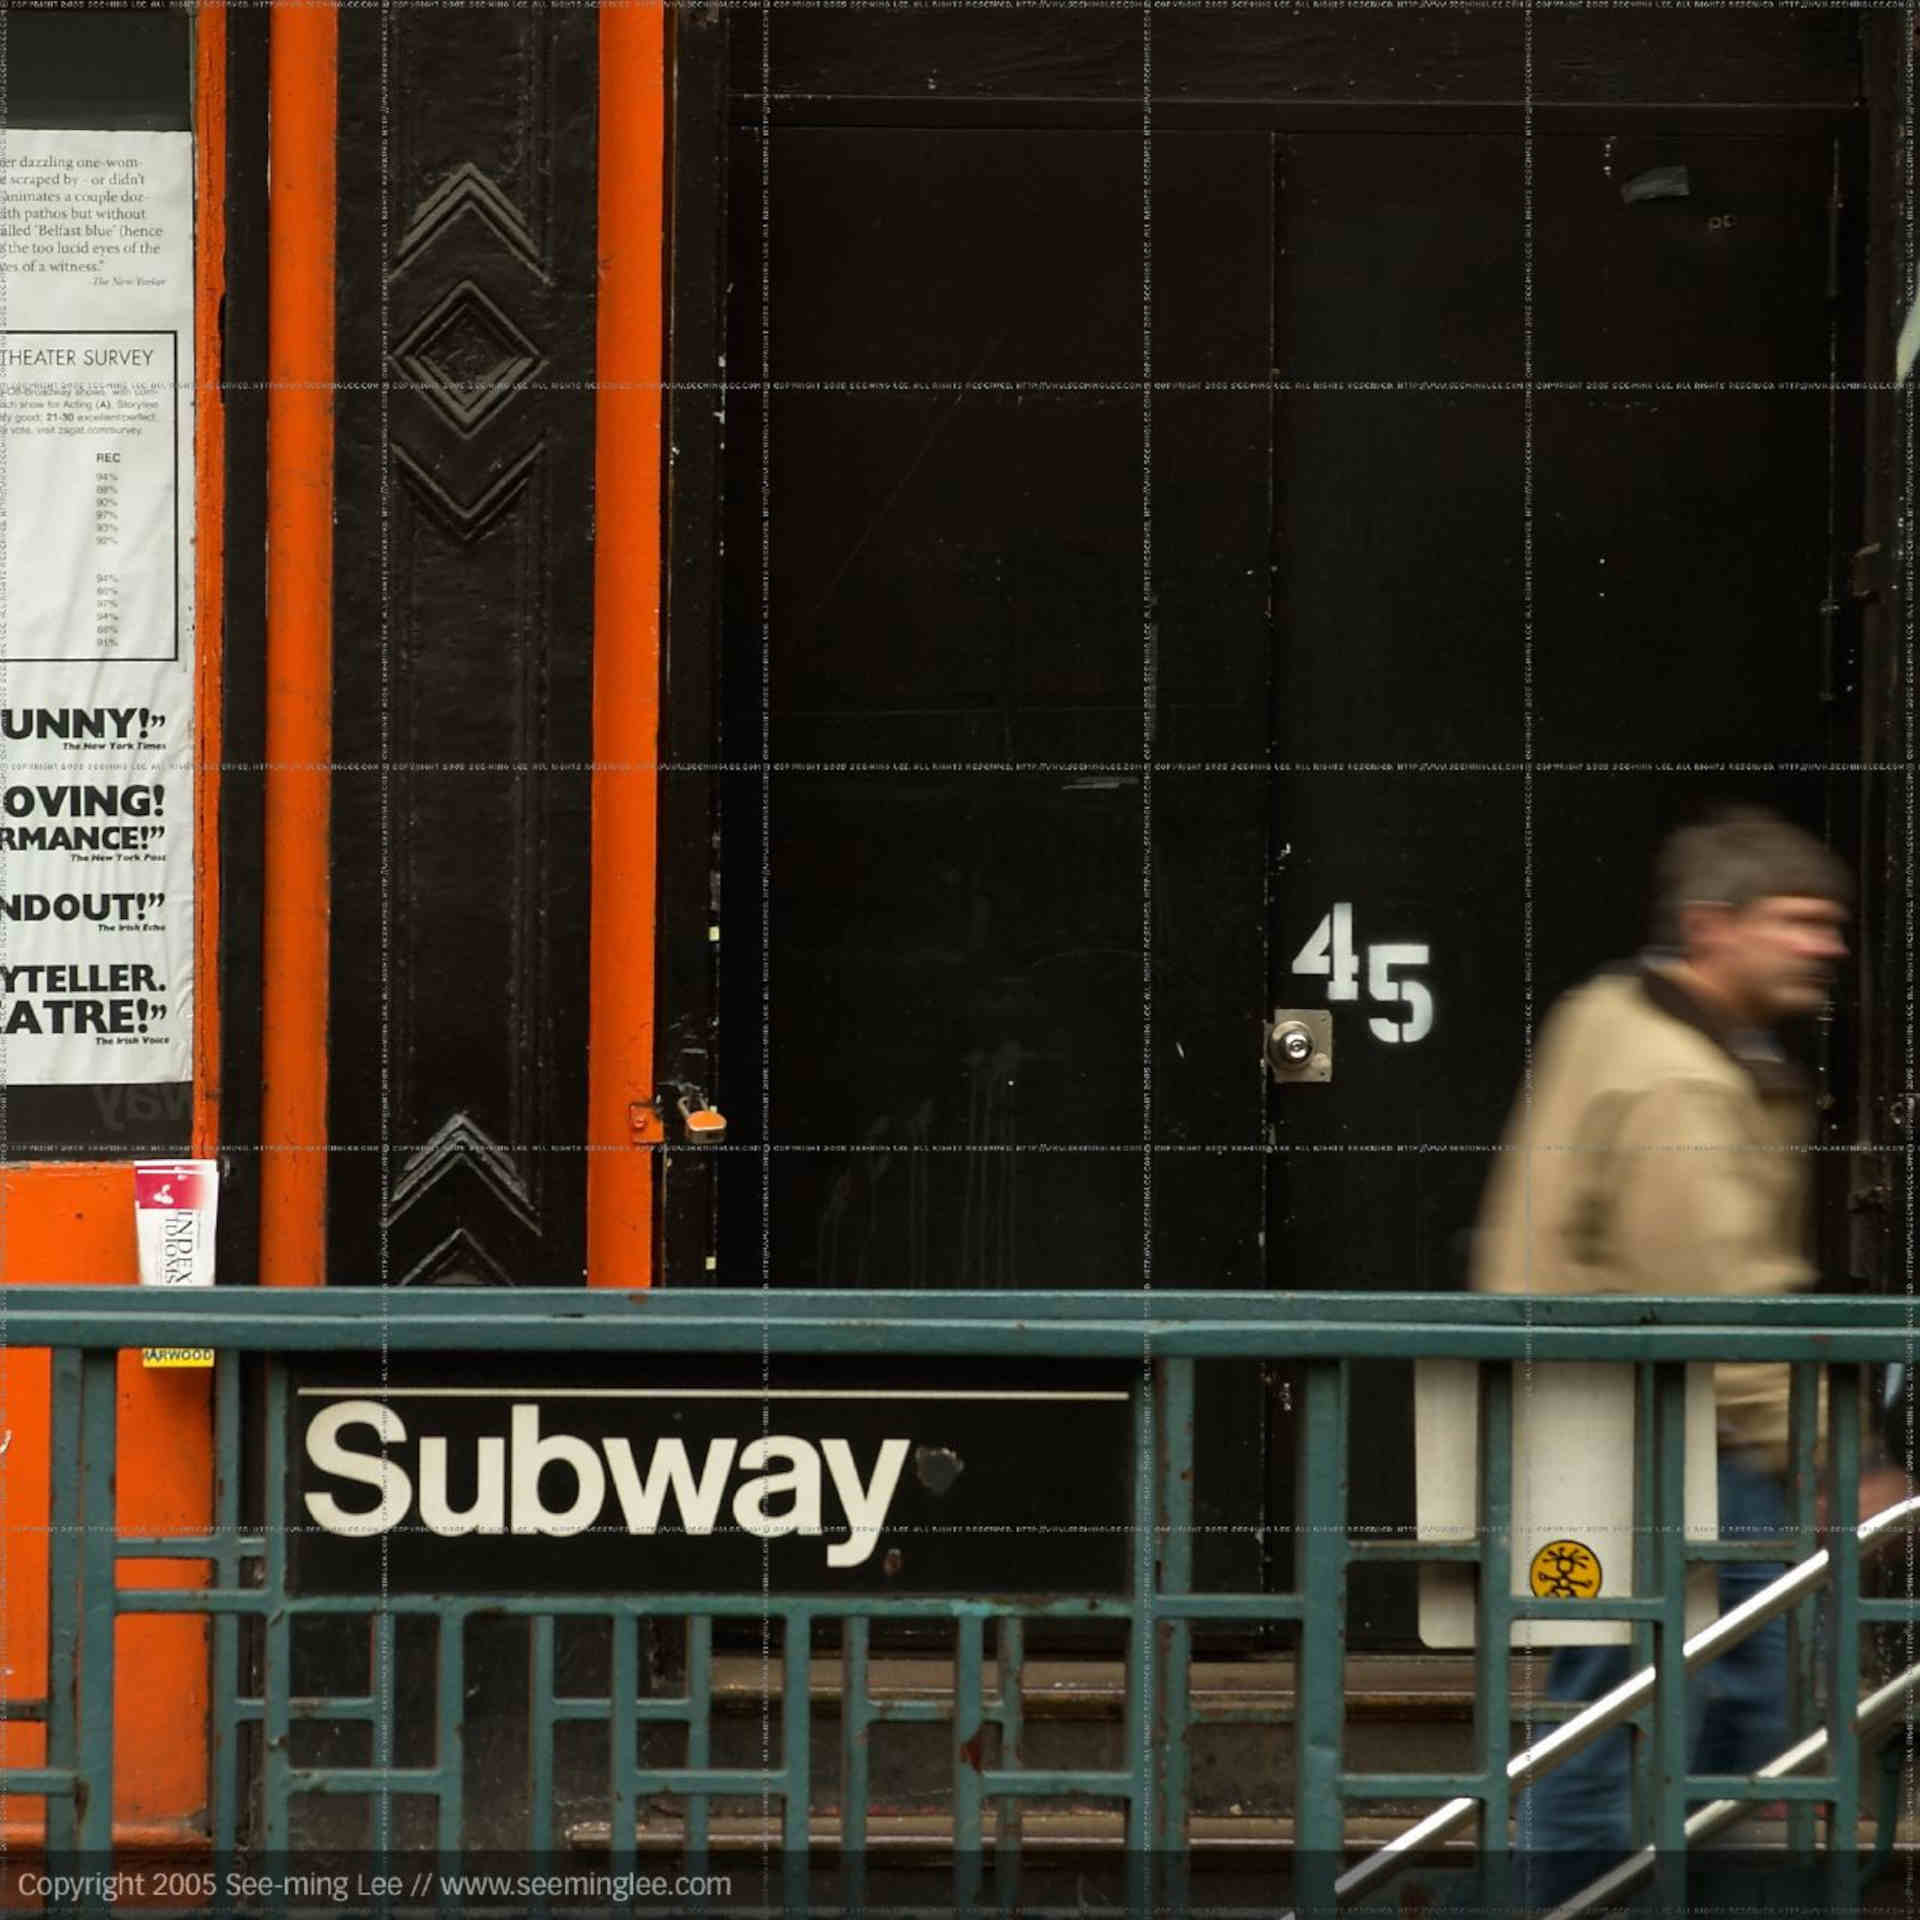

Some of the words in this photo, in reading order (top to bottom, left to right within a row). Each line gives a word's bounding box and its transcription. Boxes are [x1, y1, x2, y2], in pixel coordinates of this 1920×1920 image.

[20, 155, 72, 171] dazzling
[10, 173, 60, 189] scraped
[91, 176, 105, 185] or
[75, 191, 118, 206] couple
[25, 208, 69, 222] pathos
[72, 208, 91, 219] but
[95, 208, 144, 219] without
[9, 242, 30, 254] the
[33, 243, 54, 254] too
[58, 241, 89, 254] lucid
[93, 245, 120, 257] eyes
[123, 242, 137, 254] of
[140, 242, 161, 254] the
[22, 259, 38, 272] of
[0, 349, 77, 367] THEATER
[83, 349, 155, 367] SURVEY
[97, 452, 120, 464] REC
[63, 742, 81, 751] The
[83, 742, 106, 751] New
[109, 742, 134, 751] York
[137, 742, 167, 751] Times
[71, 854, 89, 862] The
[91, 854, 113, 862] New
[117, 854, 141, 862] York
[144, 854, 167, 862] Post
[98, 924, 116, 932] The
[119, 924, 140, 932] Irish
[142, 924, 167, 932] Echo
[1291, 902, 1432, 1043] 45
[0, 998, 168, 1035] ATRE!”
[96, 1037, 114, 1046] The
[117, 1037, 140, 1046] Irish
[143, 1037, 170, 1046] Voice
[304, 1399, 911, 1568] Subway
